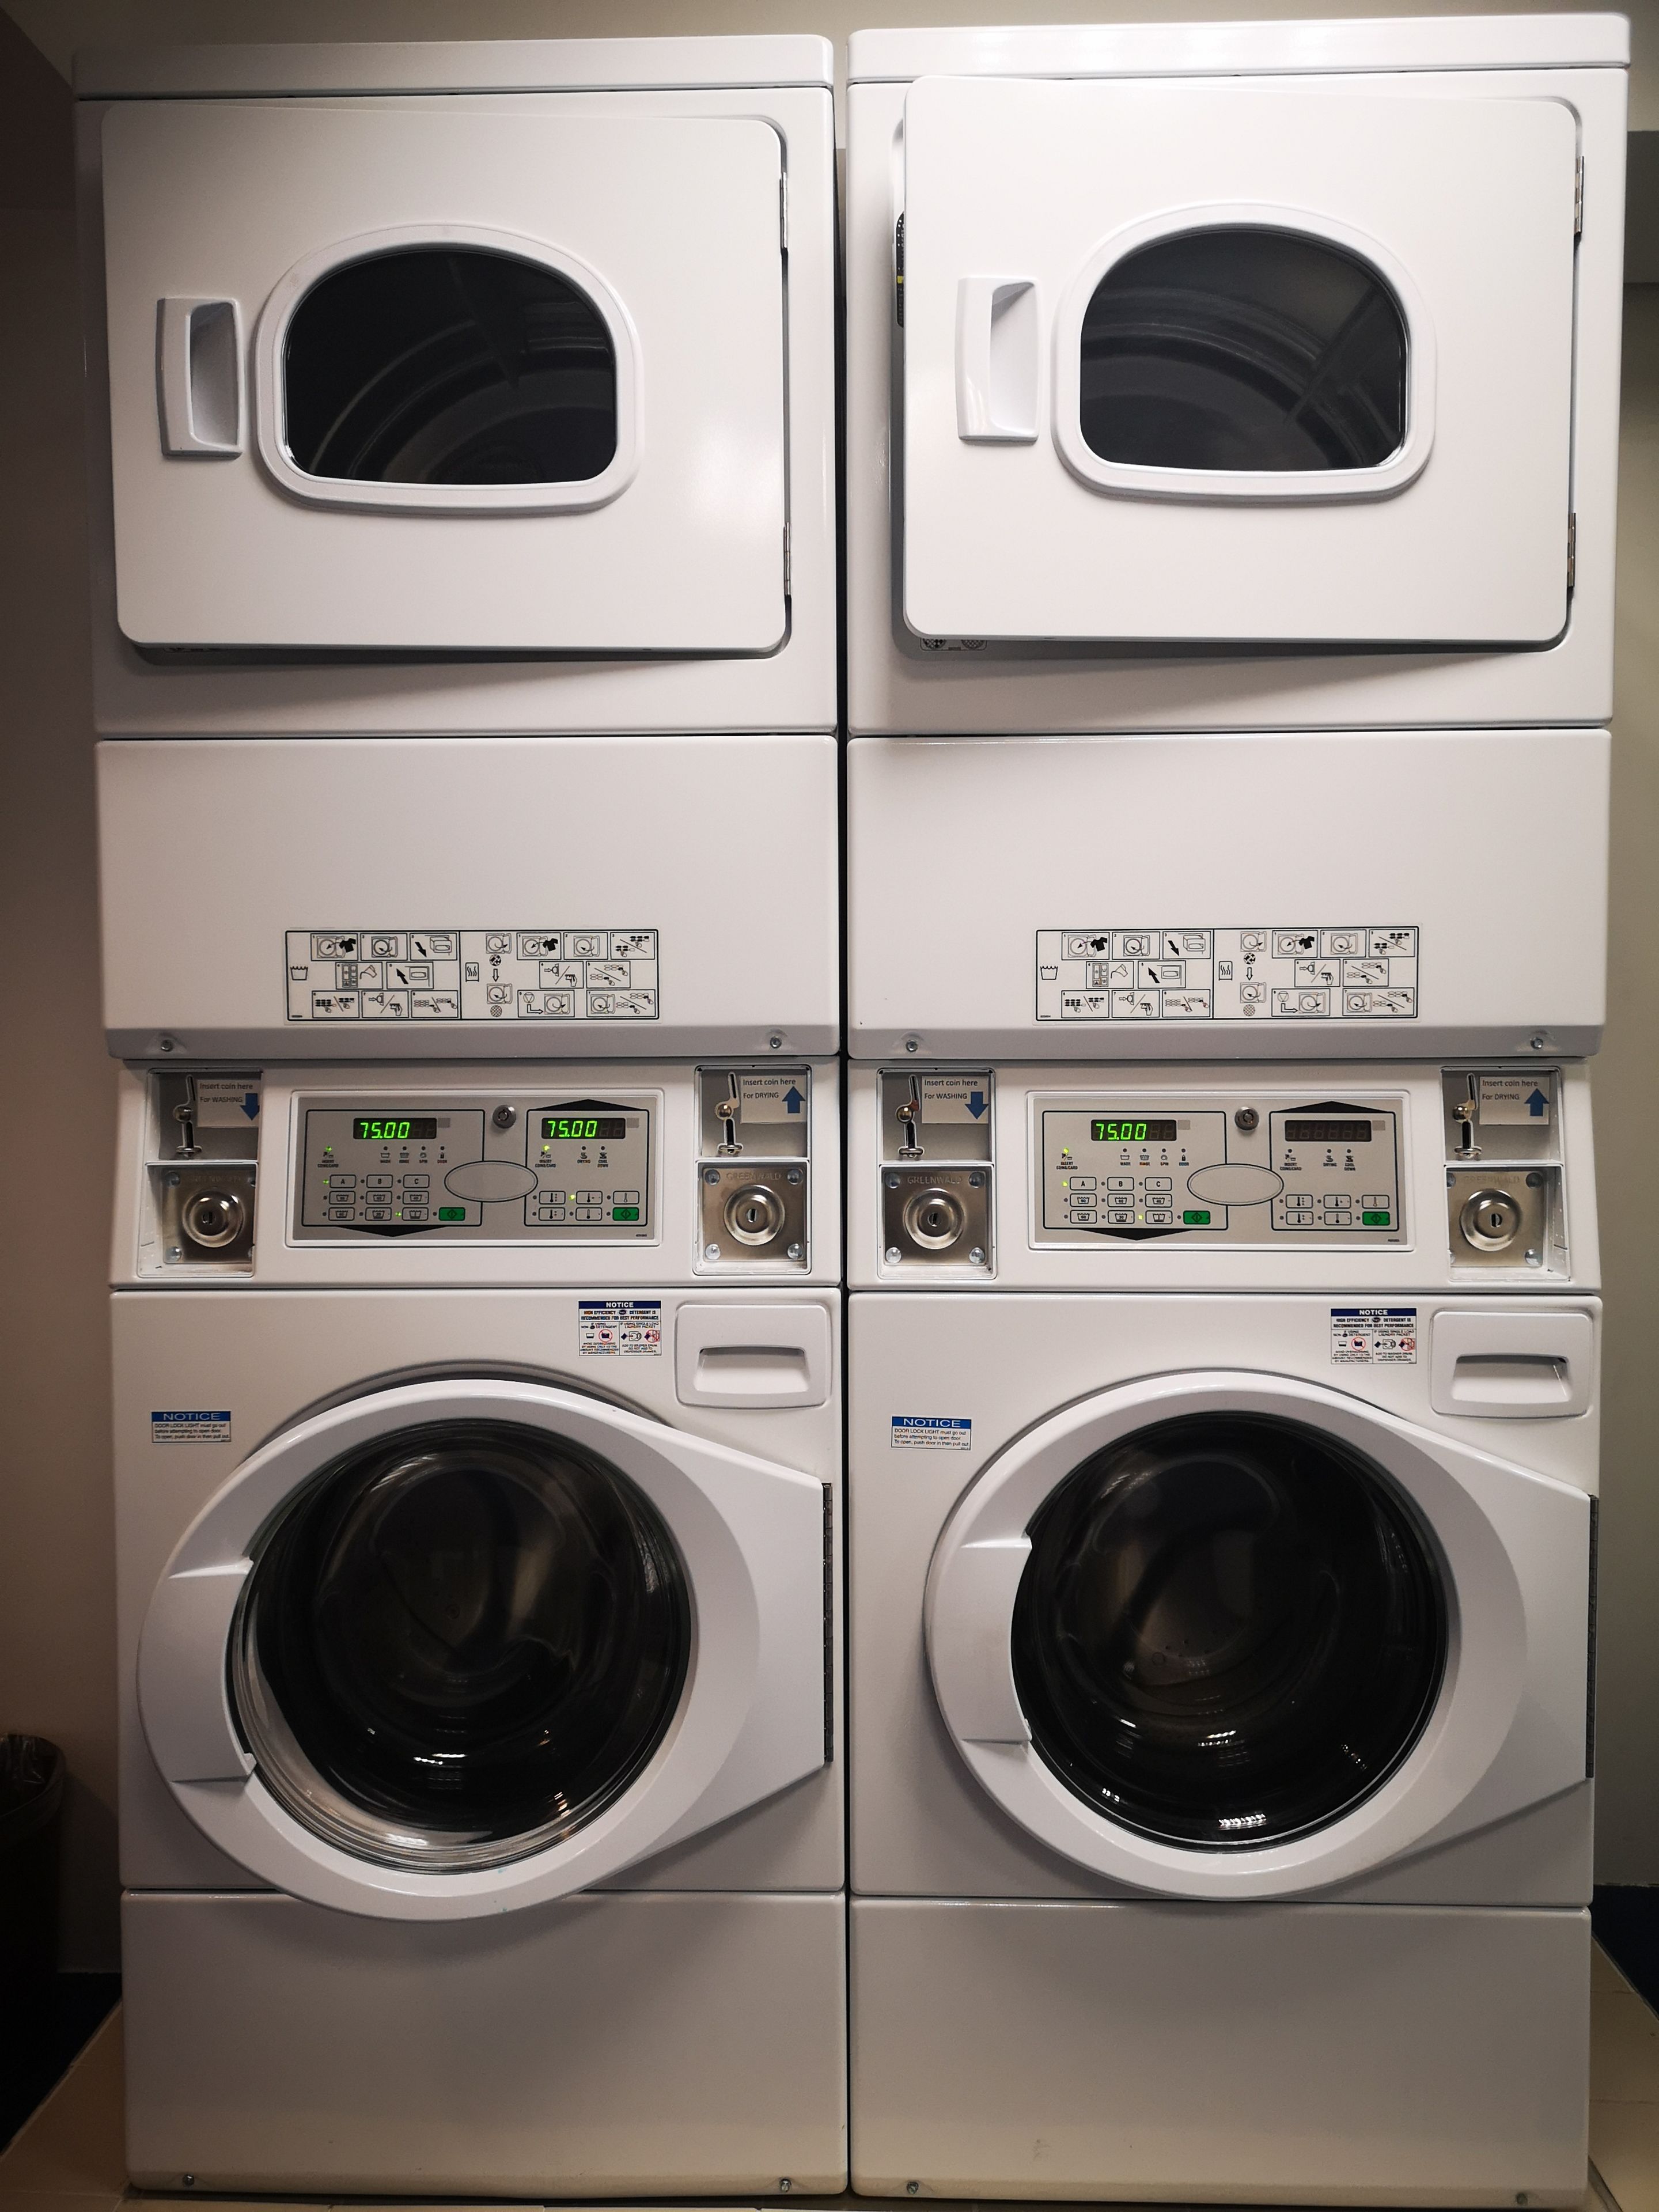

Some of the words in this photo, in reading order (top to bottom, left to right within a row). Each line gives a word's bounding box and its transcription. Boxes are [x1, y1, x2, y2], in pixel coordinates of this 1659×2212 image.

[360, 1122, 410, 1139] 75.00
[548, 1121, 597, 1137] 75.00
[1096, 1123, 1147, 1140] 75.00
[904, 1419, 961, 1427] NOTICE
